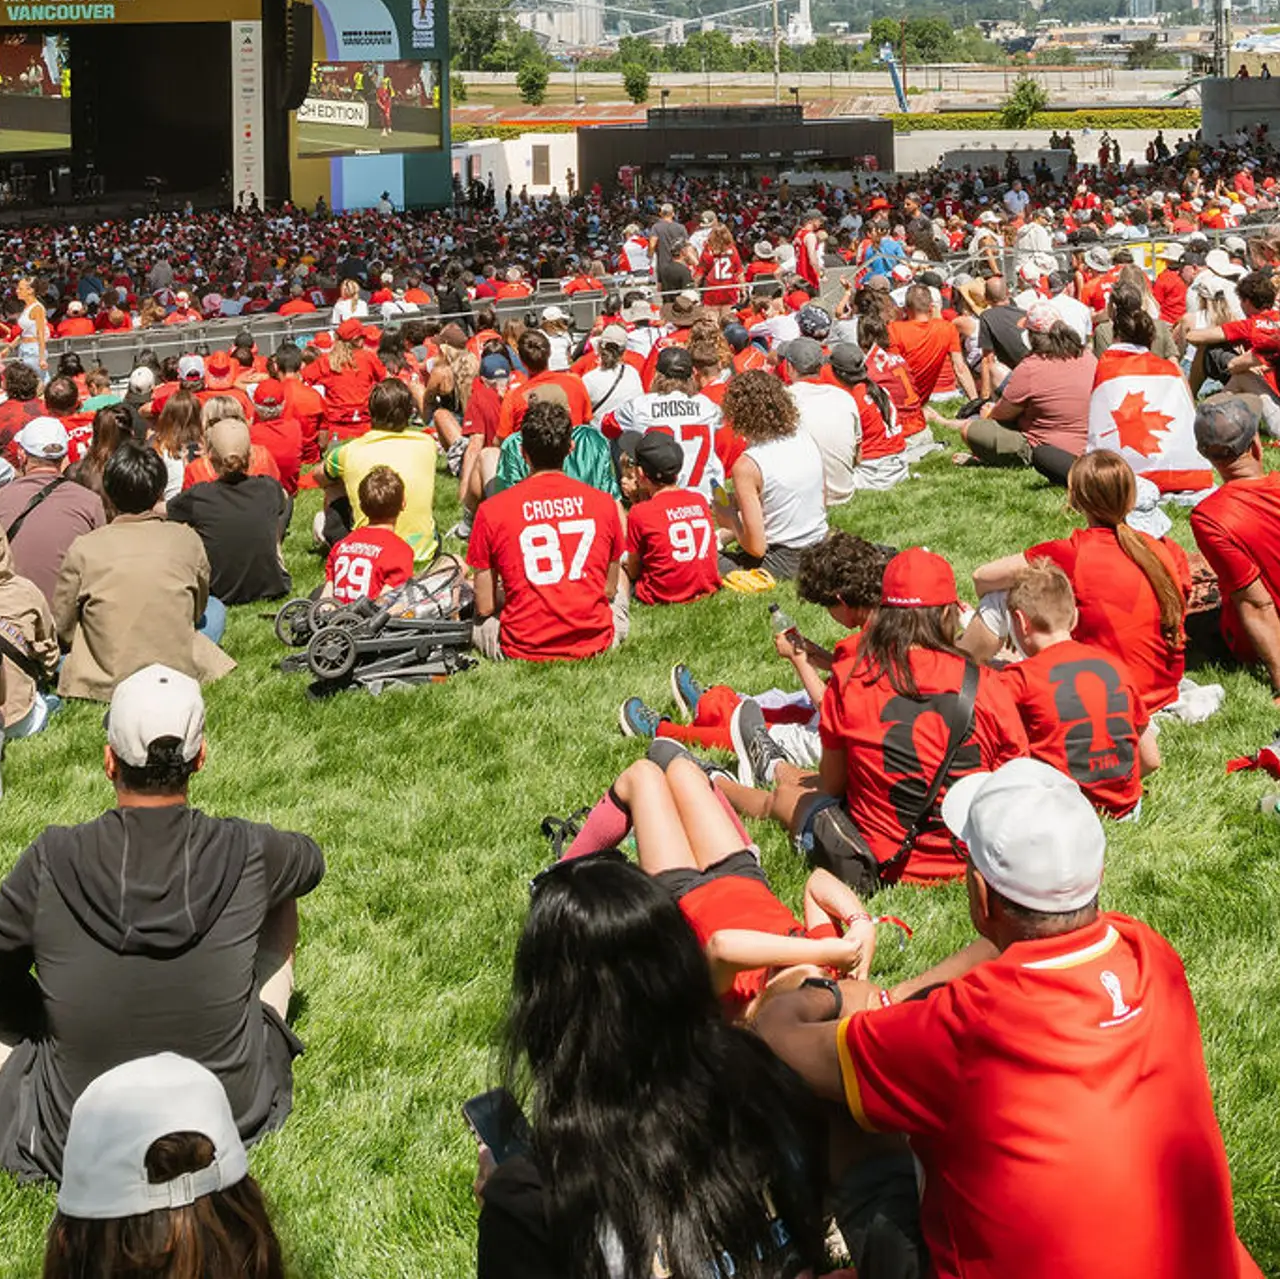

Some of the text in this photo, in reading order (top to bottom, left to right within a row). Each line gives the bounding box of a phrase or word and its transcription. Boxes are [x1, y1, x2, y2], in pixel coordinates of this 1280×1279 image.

[6, 4, 115, 20] VANCOUVER
[319, 105, 363, 120] EDITION
[713, 257, 733, 280] 12
[651, 400, 702, 419] CROSBY
[522, 496, 584, 521] CROSBY
[519, 518, 596, 586] 87
[669, 519, 711, 563] 97
[334, 556, 373, 600] 29
